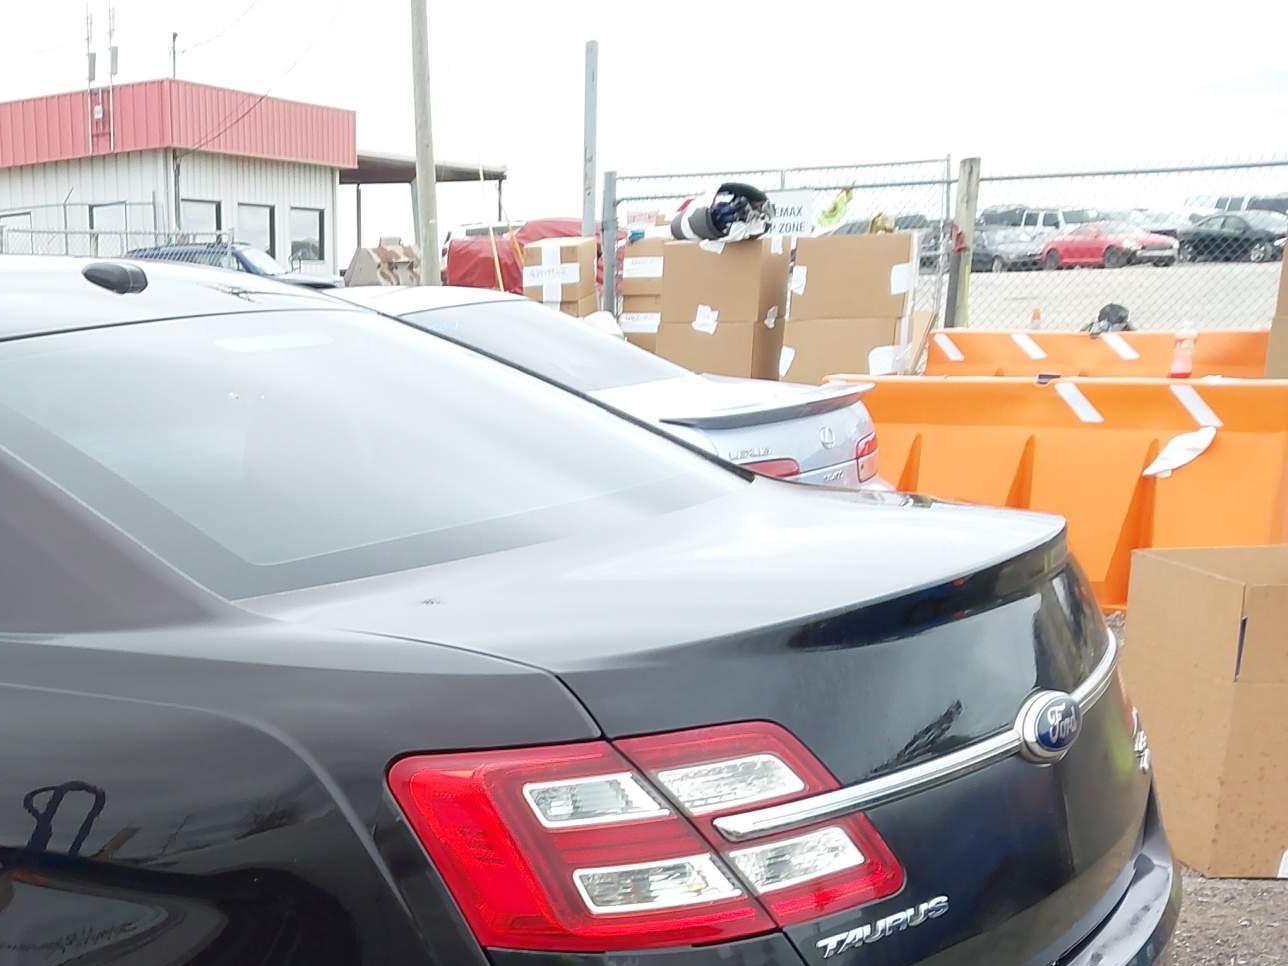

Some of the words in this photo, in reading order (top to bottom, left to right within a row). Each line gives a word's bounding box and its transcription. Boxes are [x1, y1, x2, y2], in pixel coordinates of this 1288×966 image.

[779, 221, 805, 233] ZONE
[1047, 702, 1078, 743] Ford
[815, 895, 949, 958] TAURUS
